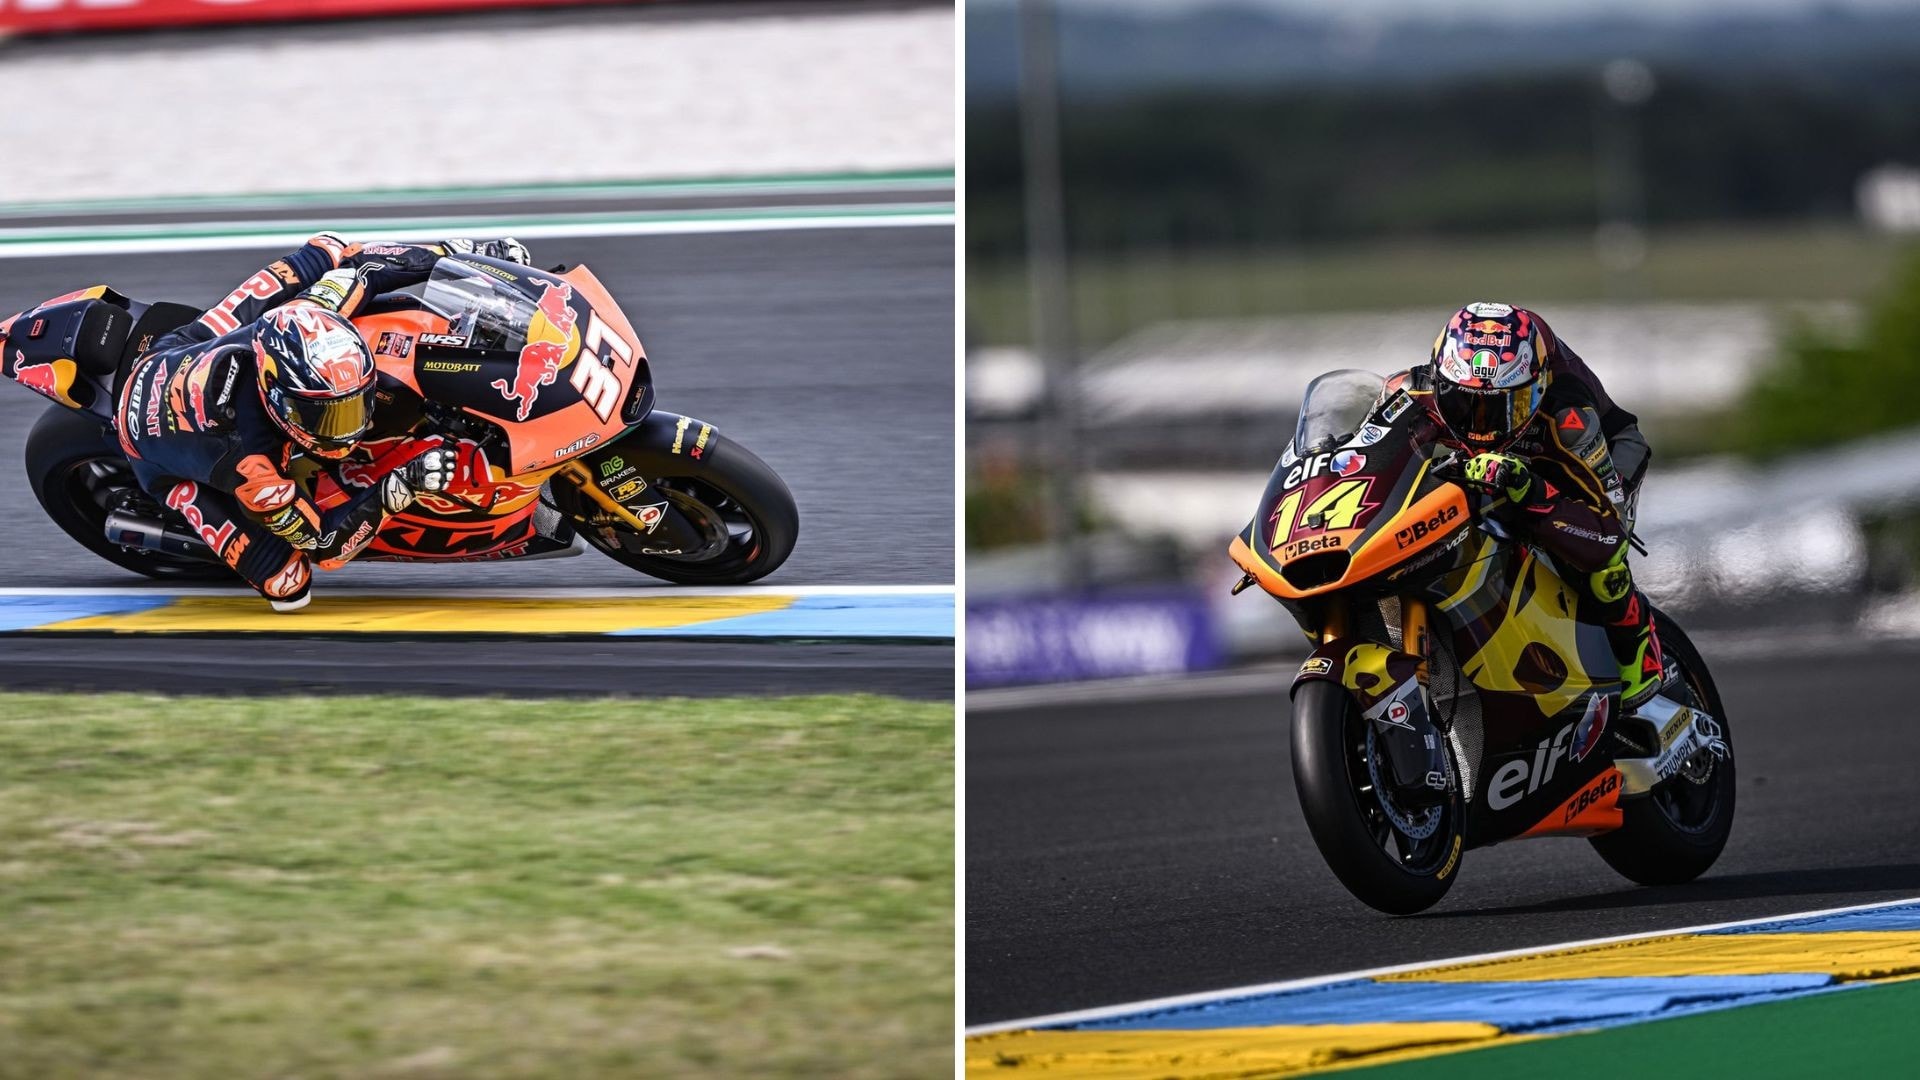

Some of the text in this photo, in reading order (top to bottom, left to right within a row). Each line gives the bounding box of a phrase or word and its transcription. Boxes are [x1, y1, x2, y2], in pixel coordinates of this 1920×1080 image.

[198, 269, 284, 338] Bull
[420, 333, 466, 346] WRS
[1464, 333, 1511, 347] Red Bull
[423, 361, 481, 372] MOTOBATT
[569, 308, 634, 426] 37
[146, 357, 168, 437] AVANT
[600, 466, 637, 487] BRAKES
[1283, 453, 1332, 490] elf
[166, 479, 237, 557] Red
[1271, 479, 1371, 550] 14
[1412, 505, 1459, 541] Beta
[223, 532, 251, 570] KTM
[341, 520, 373, 556] AVANT
[1299, 535, 1342, 554] Beta
[1487, 722, 1574, 812] elf
[1657, 743, 1694, 780] TRIUMPH
[1578, 773, 1618, 814] Beta
